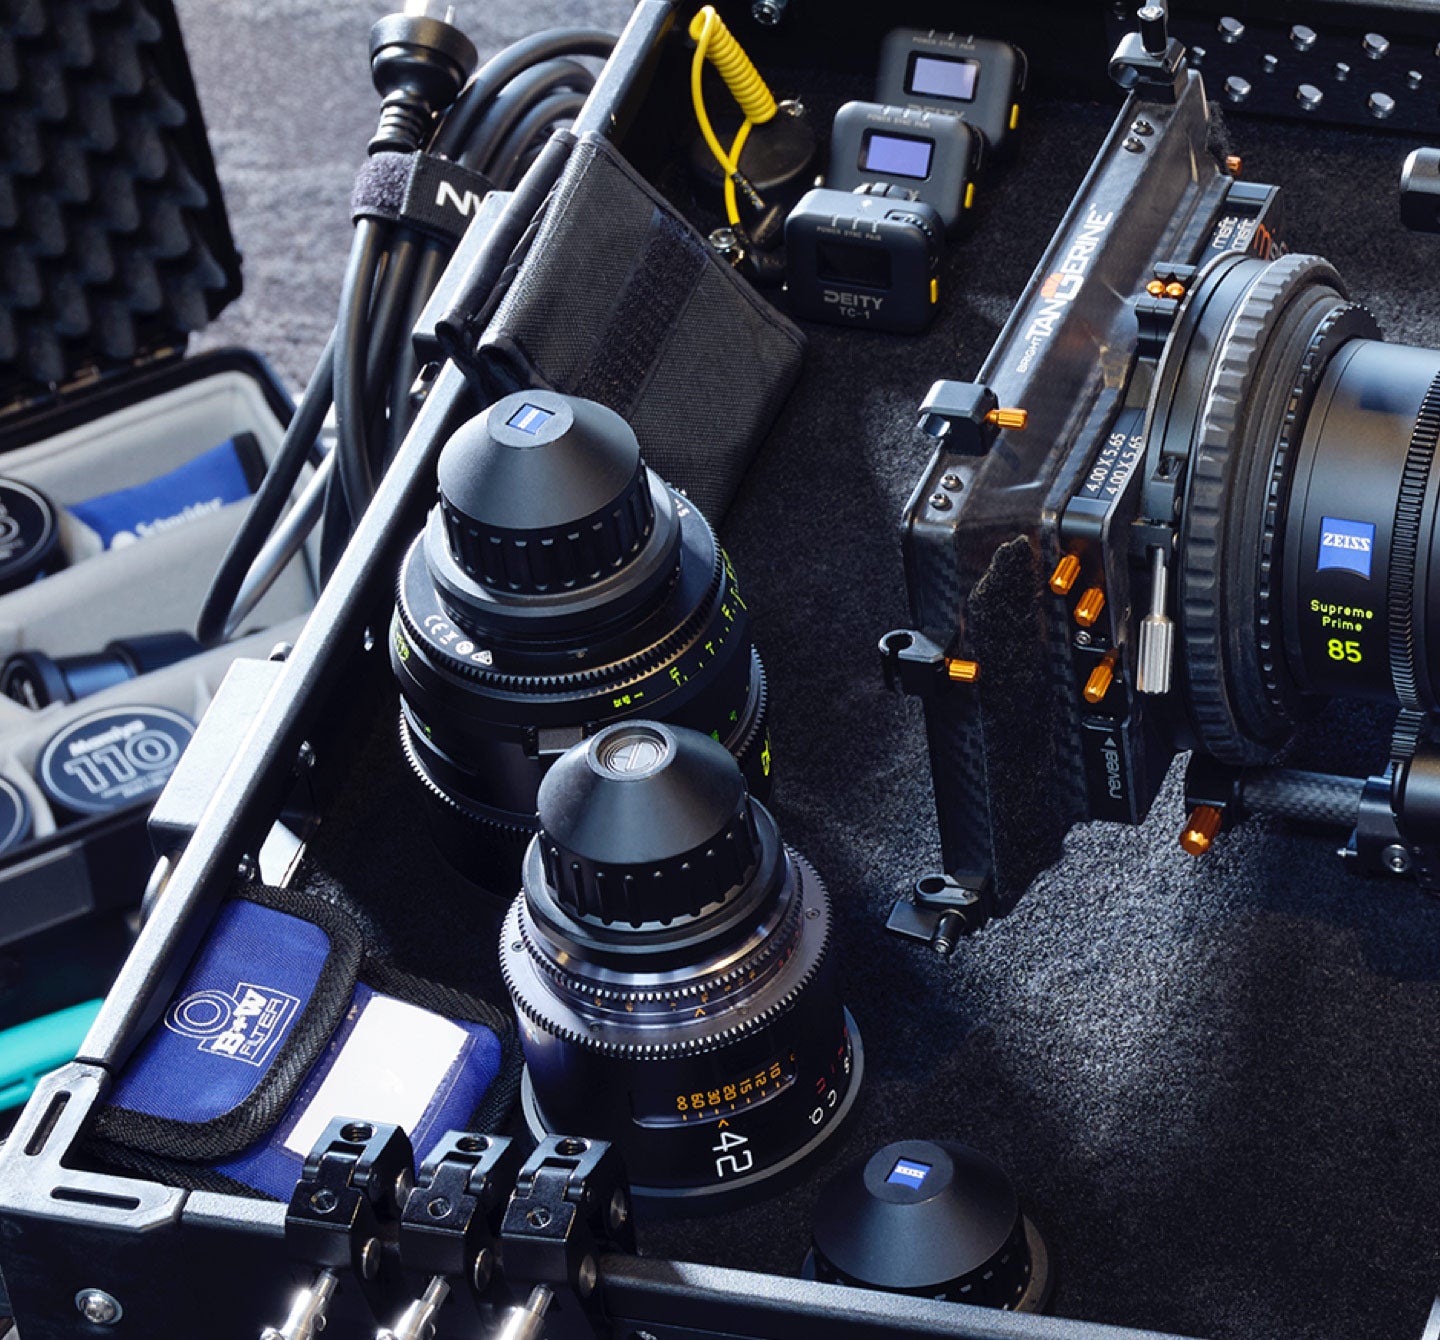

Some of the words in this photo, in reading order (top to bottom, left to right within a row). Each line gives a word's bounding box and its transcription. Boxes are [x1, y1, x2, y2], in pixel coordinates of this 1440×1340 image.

[1025, 208, 1114, 340] TANGERINE
[824, 290, 883, 310] DEITY
[1016, 335, 1042, 373] BRIGHT
[1103, 434, 1126, 460] 5.65
[1098, 453, 1113, 469] X
[1106, 471, 1128, 494] 4.00
[1126, 436, 1143, 459] 5.65
[1087, 464, 1108, 491] 4.00
[1323, 532, 1370, 552] ZEISS
[1310, 600, 1374, 620] Supreme
[1322, 616, 1362, 632] Prime
[1328, 638, 1362, 663] 85
[1101, 748, 1122, 800] reveal
[212, 988, 268, 1055] B+W
[691, 1093, 705, 1110] 60
[707, 1090, 721, 1106] 30
[723, 1084, 737, 1101] 20
[740, 1078, 752, 1094] 15
[754, 1071, 767, 1088] 12
[770, 1062, 782, 1079] 10
[712, 1131, 753, 1177] 42
